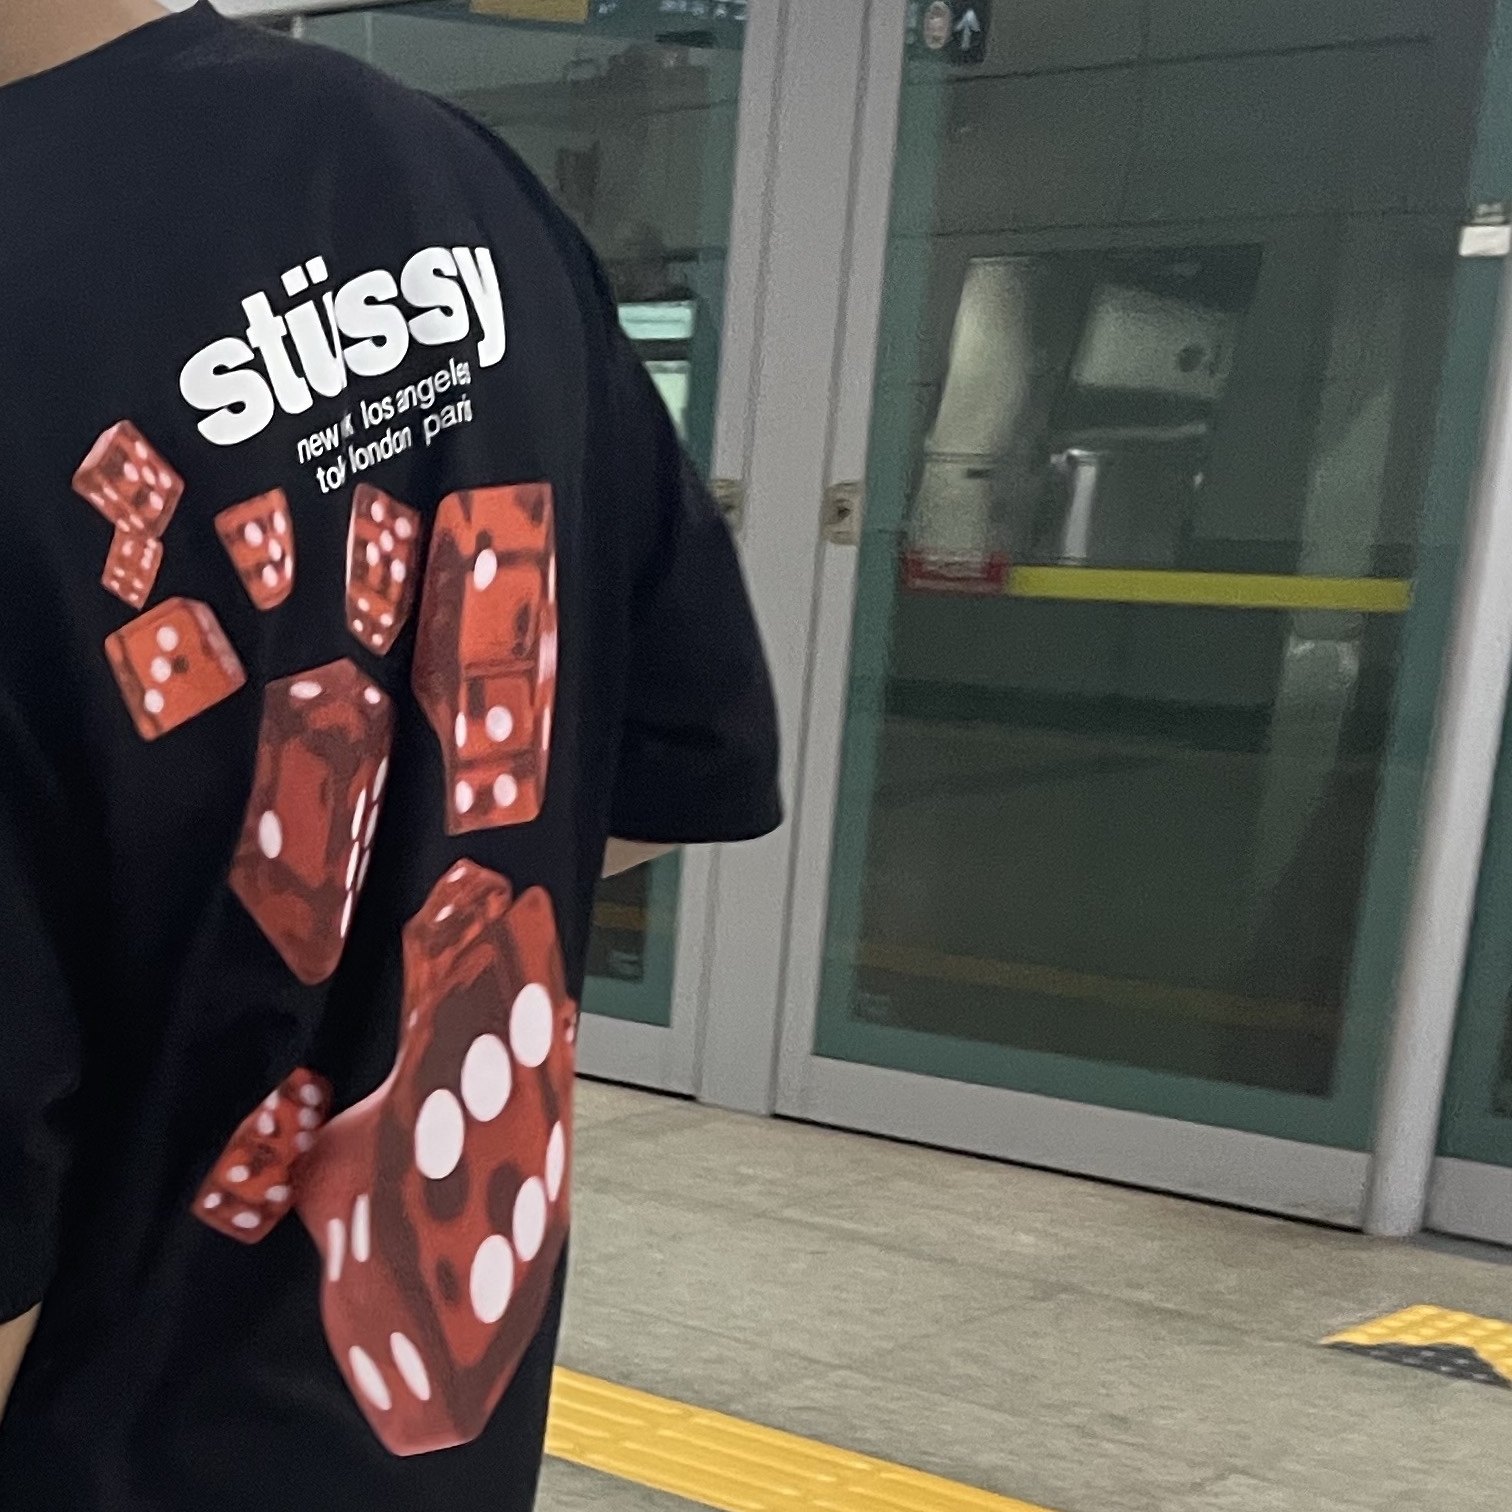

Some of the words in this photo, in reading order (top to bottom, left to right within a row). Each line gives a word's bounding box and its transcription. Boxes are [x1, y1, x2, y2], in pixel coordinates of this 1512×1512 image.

[179, 246, 506, 446] stüssy
[297, 423, 340, 464] new
[360, 393, 395, 430] los
